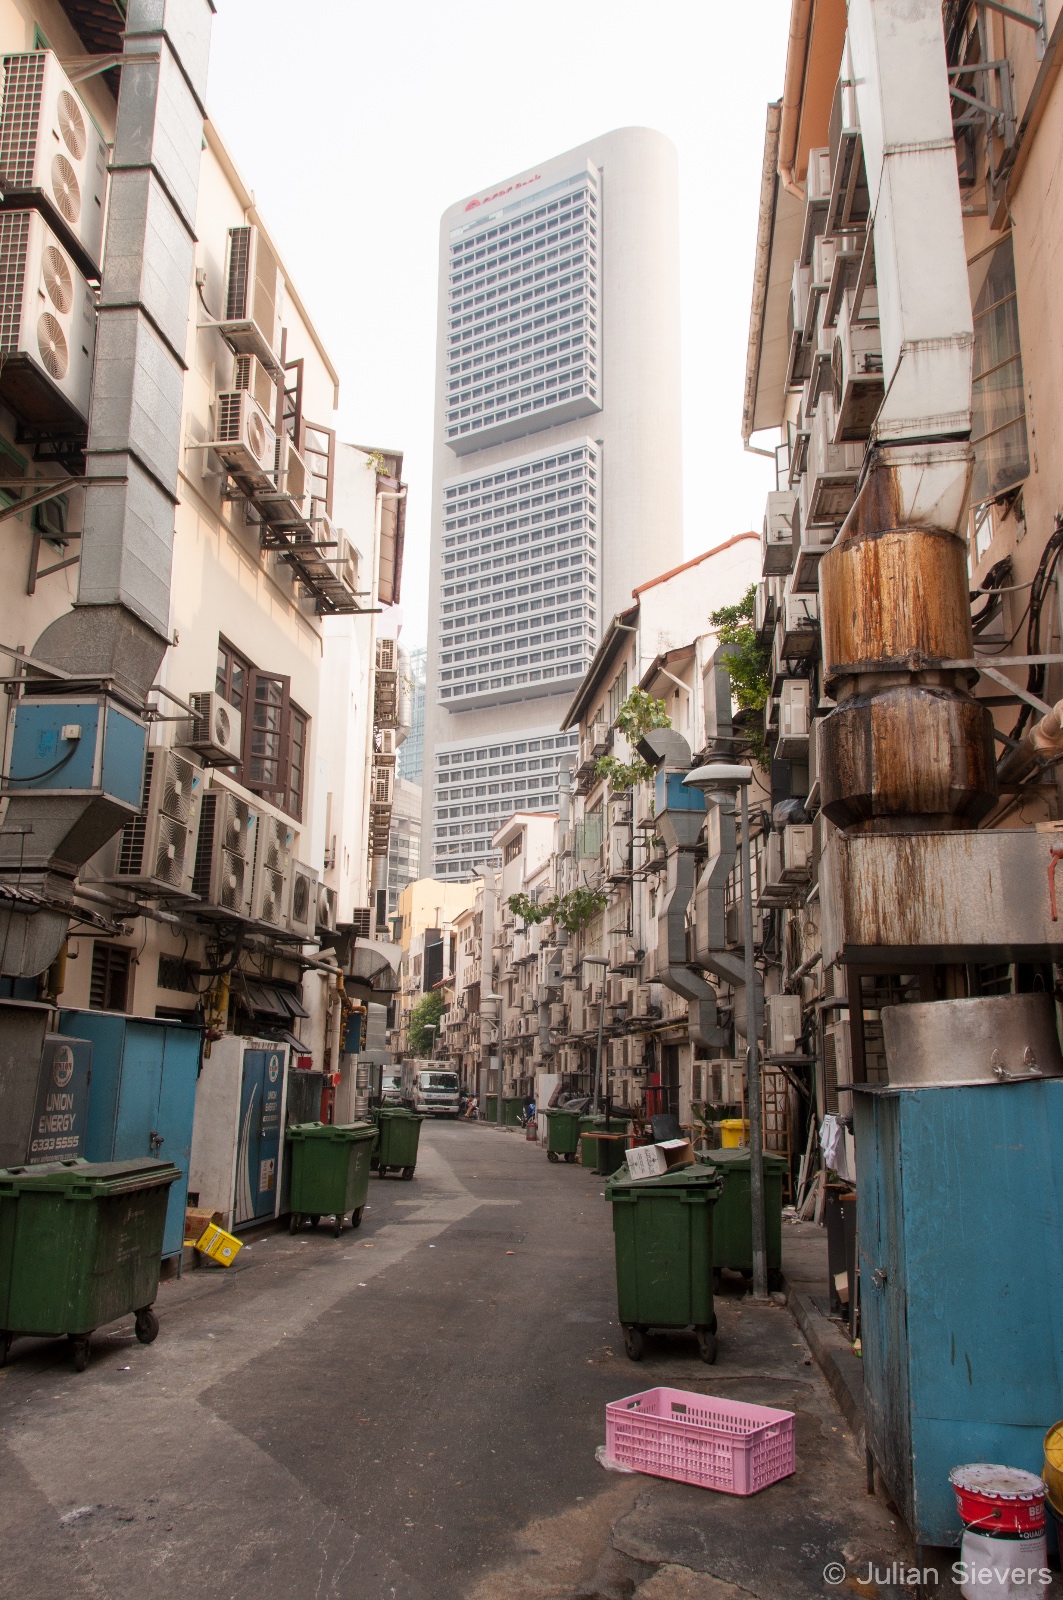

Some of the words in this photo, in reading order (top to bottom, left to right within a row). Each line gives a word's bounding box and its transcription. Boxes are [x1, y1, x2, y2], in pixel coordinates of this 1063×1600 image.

[55, 1062, 73, 1070] UNION
[46, 1093, 73, 1111] UNION
[38, 1113, 76, 1133] ENERGY
[31, 1138, 55, 1152] 6333
[55, 1135, 79, 1149] 5555
